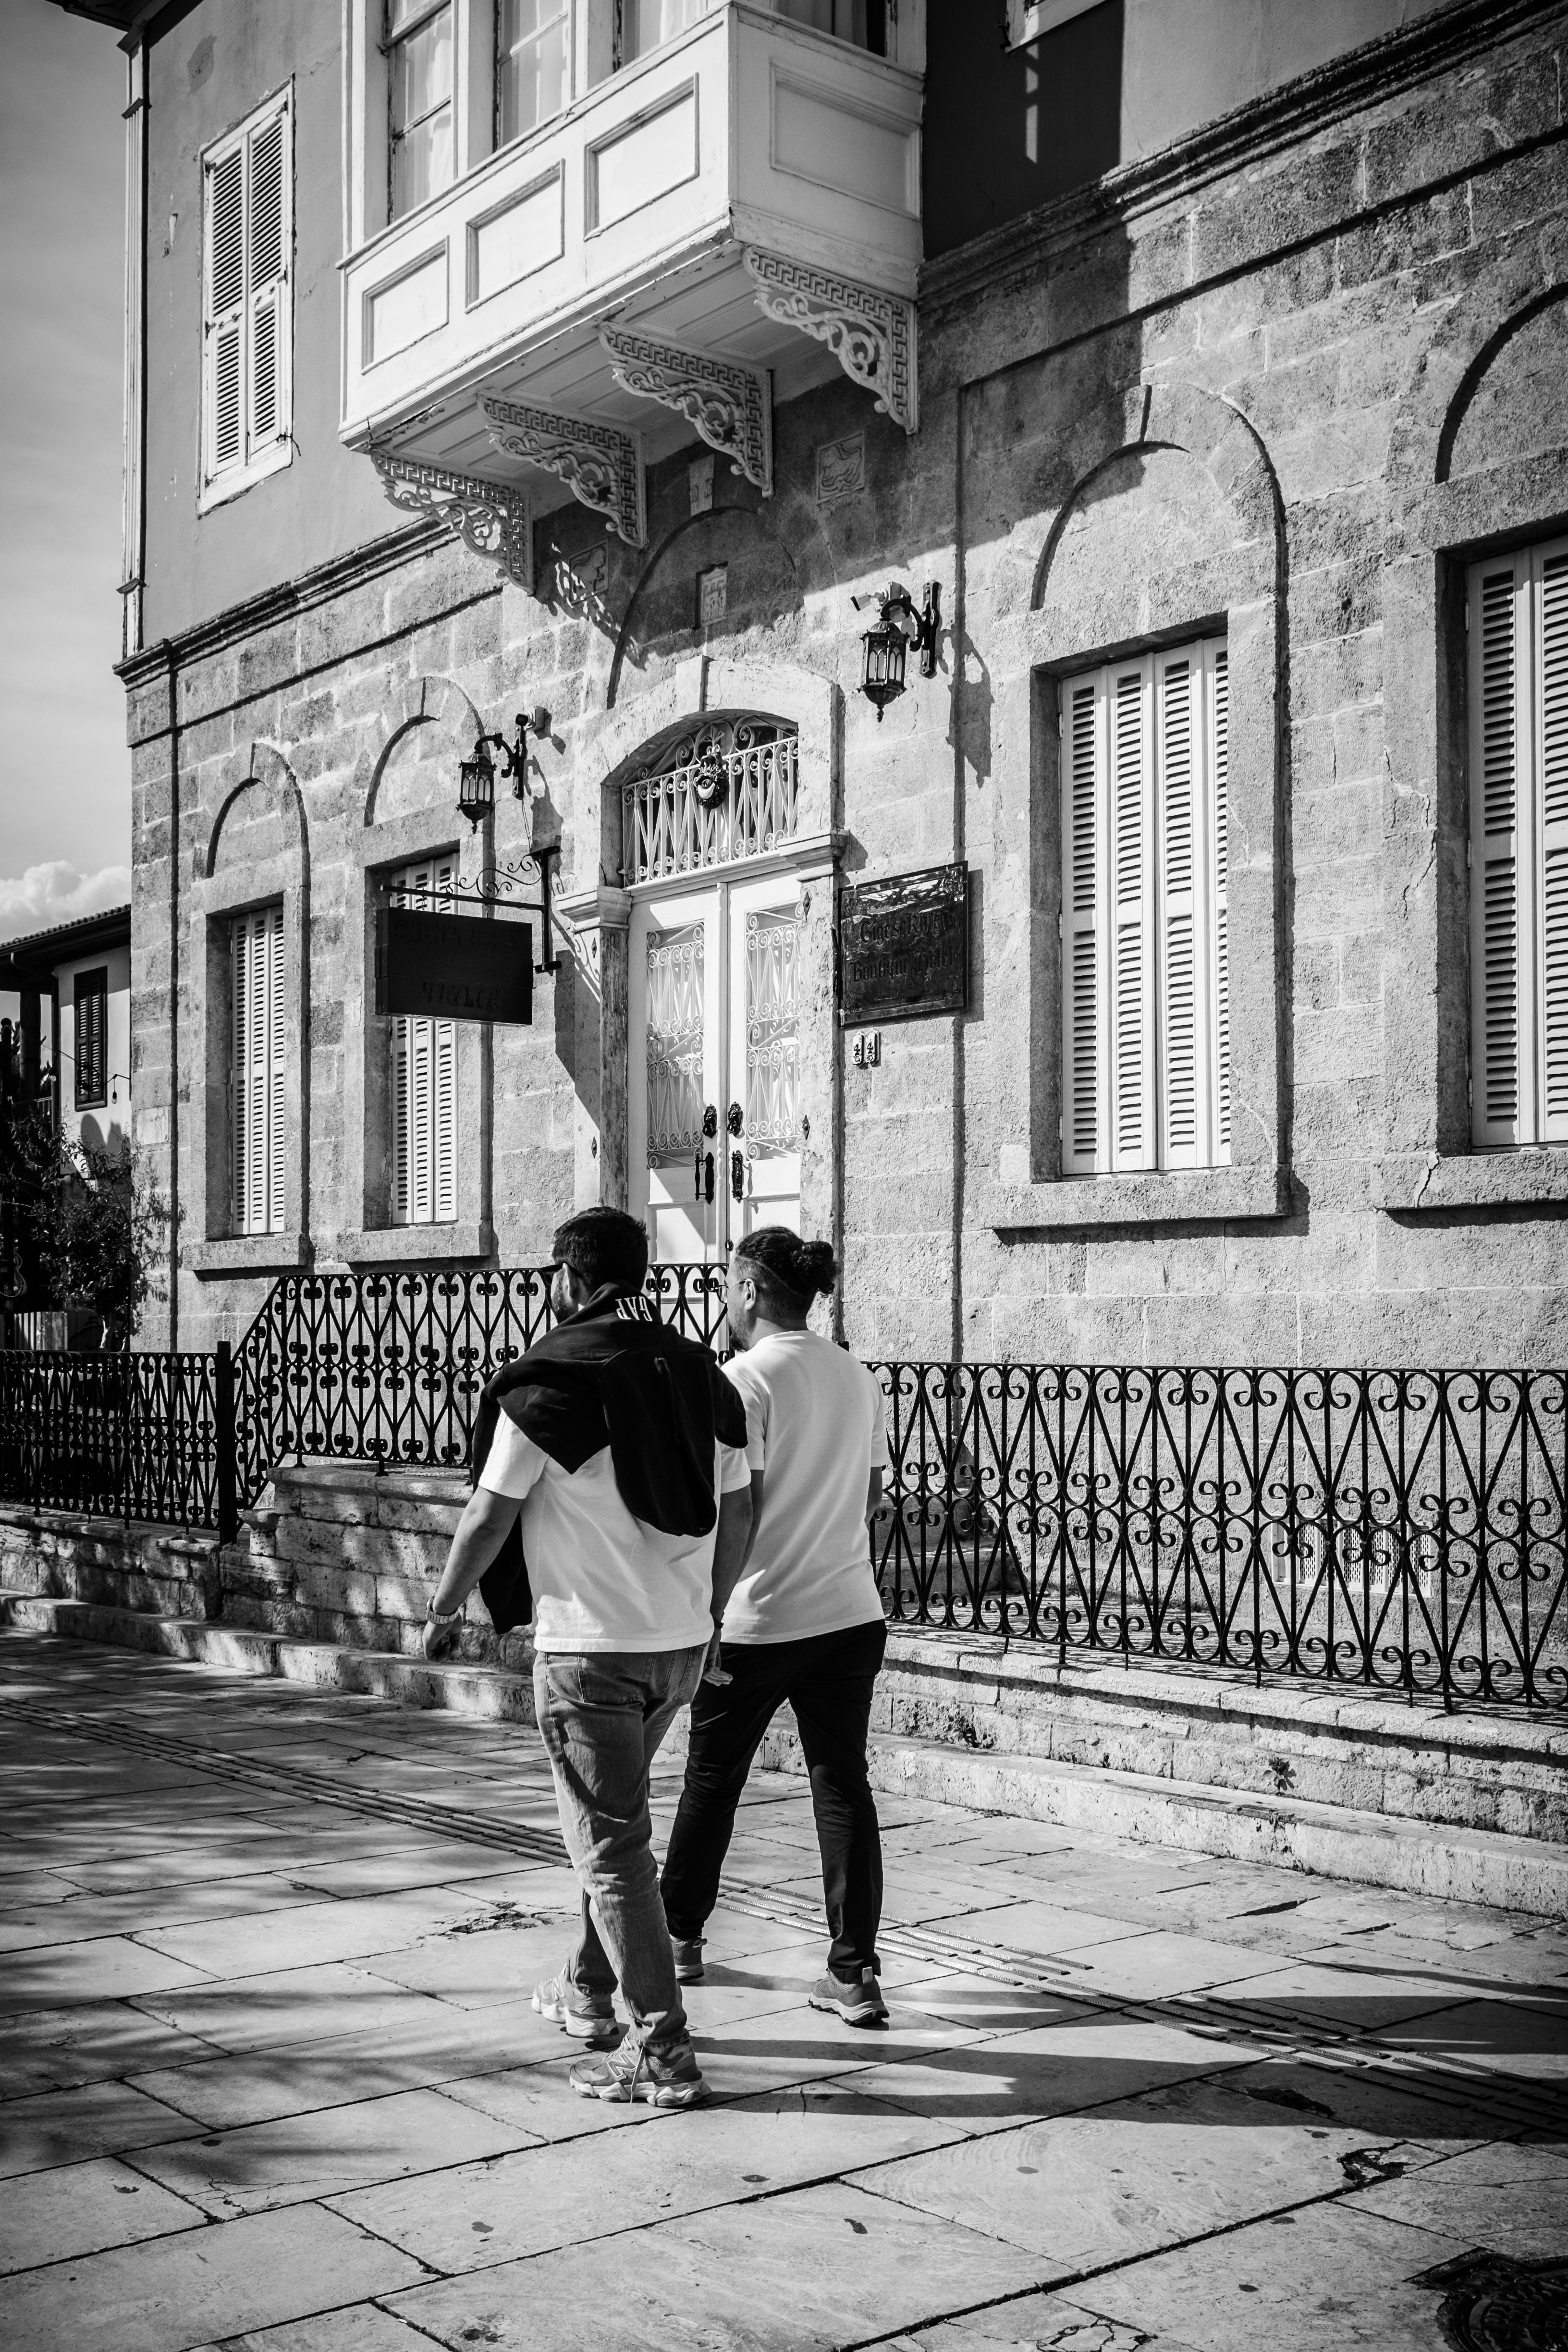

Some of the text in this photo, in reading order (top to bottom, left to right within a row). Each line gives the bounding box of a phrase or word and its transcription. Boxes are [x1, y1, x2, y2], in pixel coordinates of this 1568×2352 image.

[904, 911, 945, 937] King
[849, 946, 954, 983] Boutique Hotel
[615, 1296, 653, 1322] GAP
[552, 1978, 566, 2001] N
[606, 2052, 637, 2078] N
